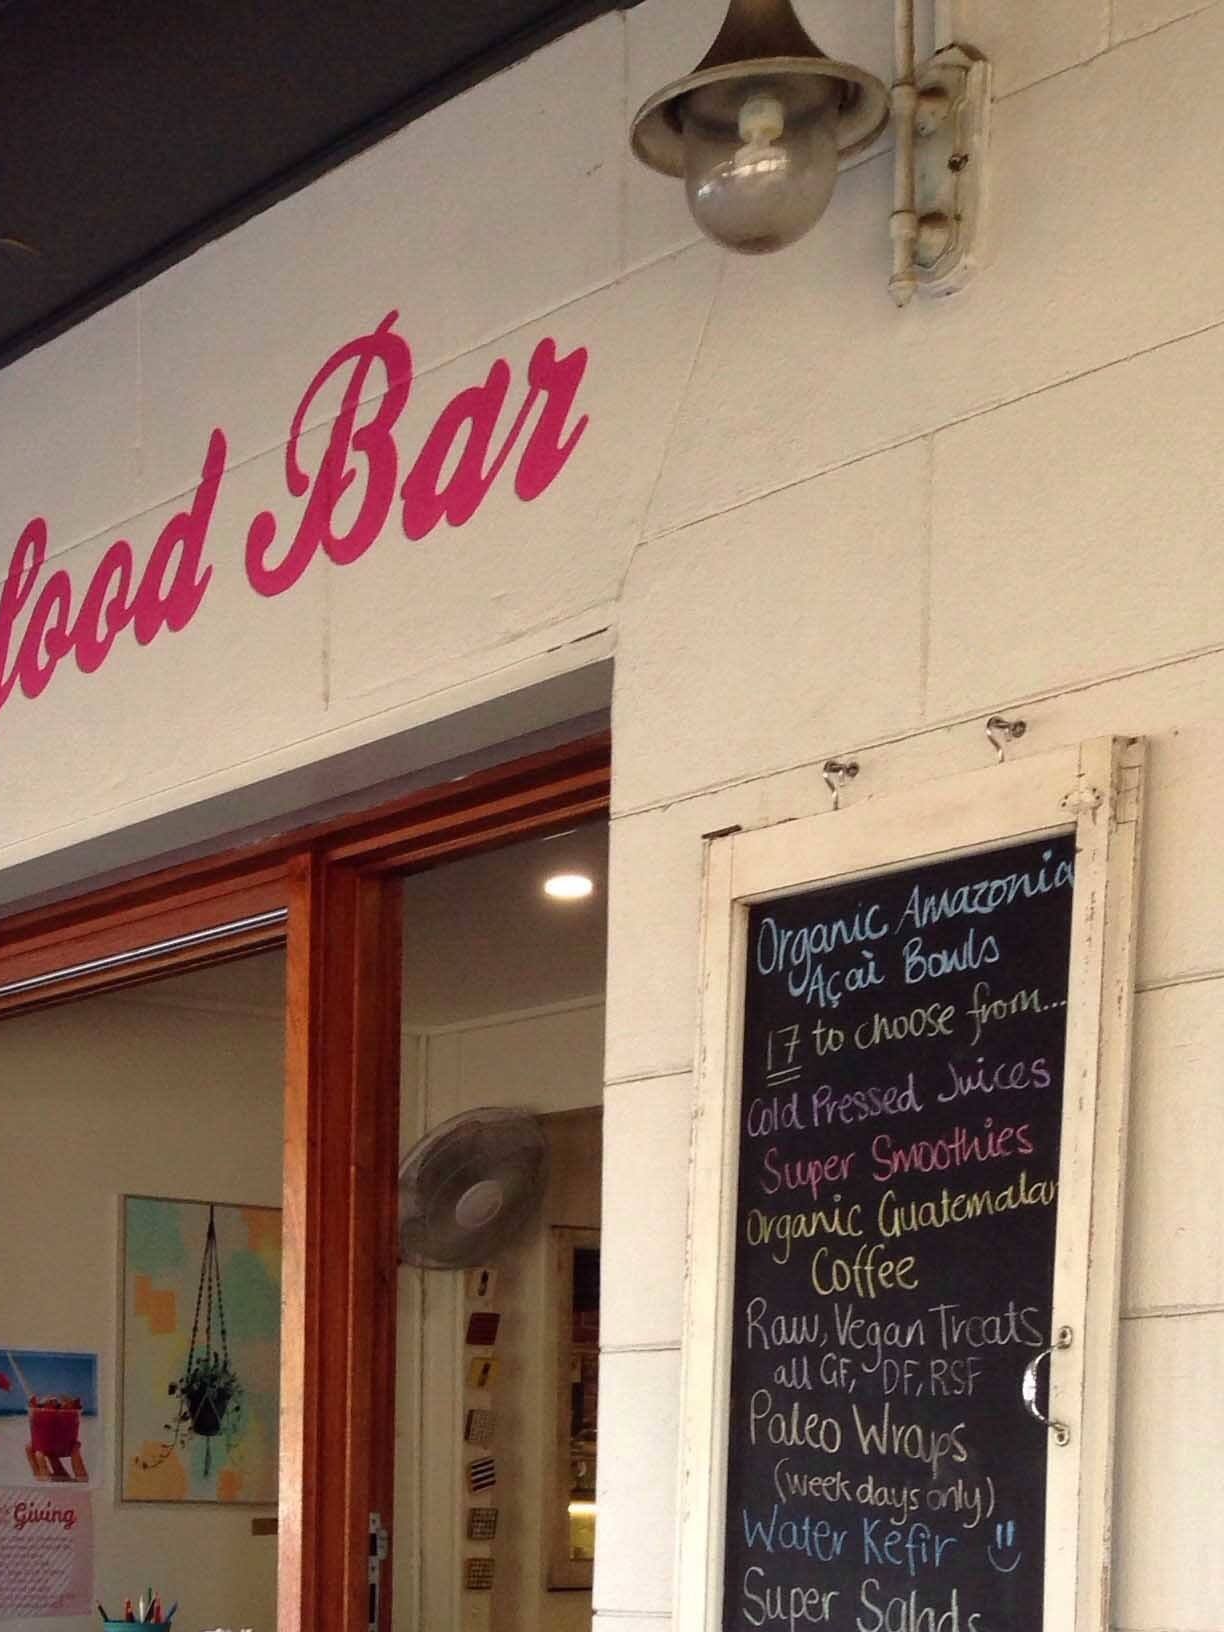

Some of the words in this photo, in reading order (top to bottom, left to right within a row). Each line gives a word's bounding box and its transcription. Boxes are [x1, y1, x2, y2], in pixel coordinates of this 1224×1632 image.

[243, 309, 589, 598] Bar
[756, 903, 890, 997] Organic
[902, 927, 1000, 984] Bowls
[765, 1024, 801, 1074] 17
[811, 1018, 844, 1058] to
[854, 1003, 955, 1051] choose
[746, 1086, 804, 1138] Cold
[812, 1073, 924, 1127] Pressed
[937, 1055, 1052, 1102] Juices
[760, 1146, 856, 1201] Super
[871, 1117, 1034, 1183] Smoothies
[746, 1193, 864, 1264] Organic
[810, 1243, 919, 1300] Coffee
[834, 1303, 925, 1373] Vegan
[928, 1300, 1044, 1351] Treats
[774, 1355, 813, 1391] all
[930, 1356, 984, 1397] RSF
[749, 1388, 842, 1454] Paleo
[852, 1401, 968, 1480] Wraps
[14, 1501, 77, 1530] Giving
[742, 1502, 848, 1564] Water
[862, 1517, 960, 1577] Kefir
